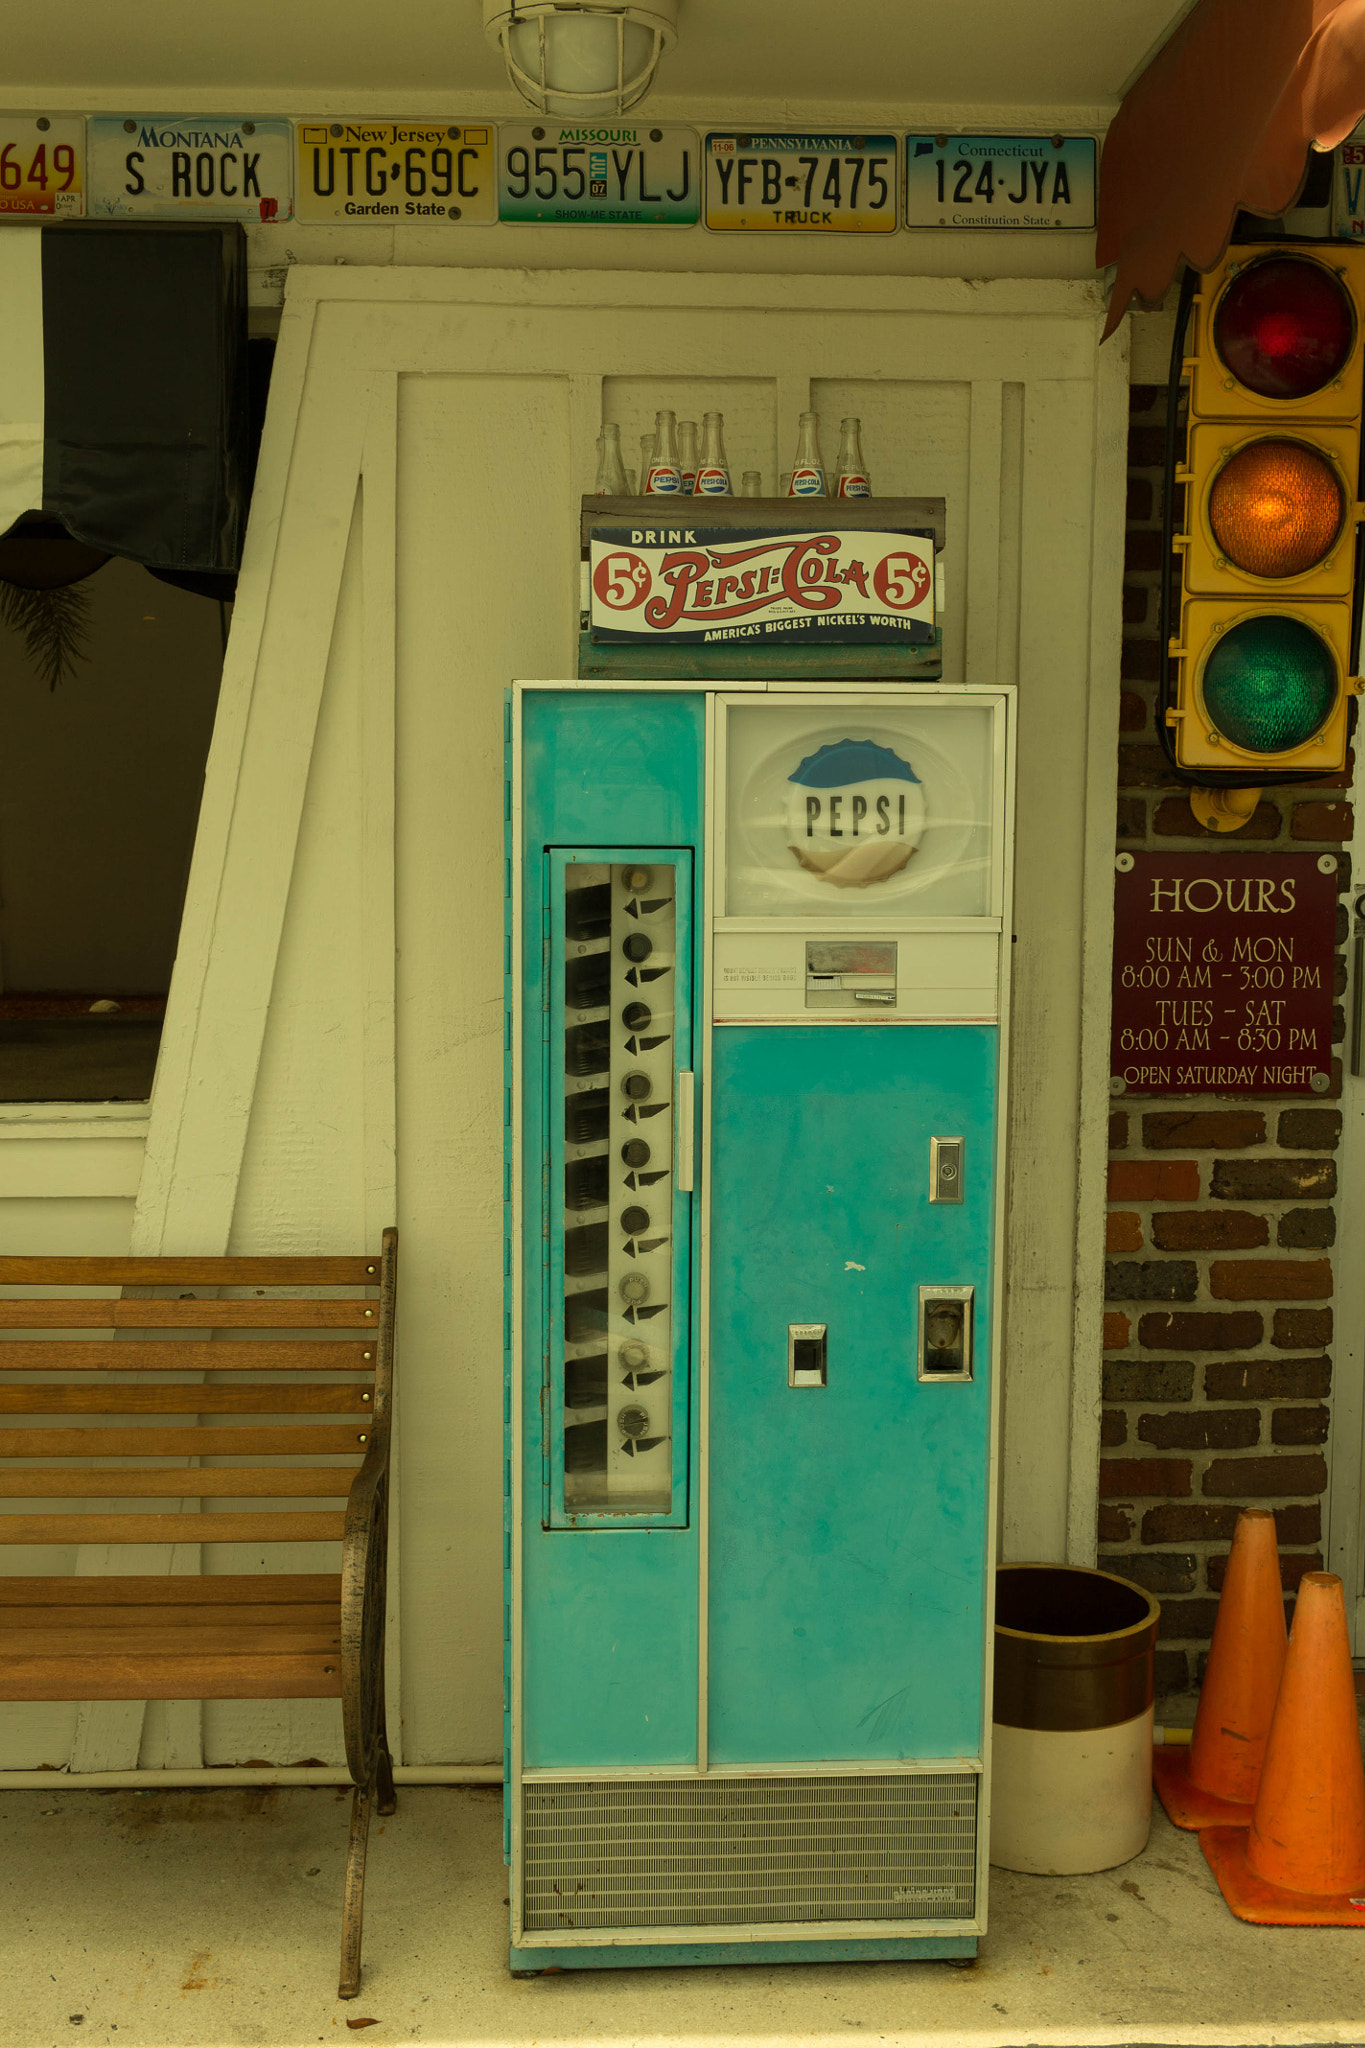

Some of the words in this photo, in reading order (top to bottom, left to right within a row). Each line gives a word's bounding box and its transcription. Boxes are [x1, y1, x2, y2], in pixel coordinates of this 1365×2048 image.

[137, 126, 244, 149] MONTANA
[345, 126, 388, 143] New
[390, 126, 447, 146] Jersey
[559, 129, 637, 143] MISSOURI
[751, 137, 853, 151] PENNSYLVANIA
[958, 143, 1043, 157] Connecticut
[0, 143, 75, 191] 649
[126, 152, 144, 195] S
[172, 152, 261, 198] ROCK
[507, 147, 586, 200] 955
[612, 150, 689, 202] YLJ
[591, 155, 606, 177] JUL
[11, 200, 35, 210] USA
[345, 202, 399, 215] Garden
[405, 202, 446, 215] State
[555, 210, 605, 219] SHOW-ME
[609, 211, 642, 220] STATE
[773, 211, 832, 224] TRUCK
[952, 214, 1020, 225] Constitution
[1023, 215, 1050, 226] State
[654, 476, 680, 484] PEPSI
[631, 530, 697, 544] DRINK
[606, 557, 647, 605] 5¢
[885, 557, 927, 605] 5¢
[704, 623, 761, 642] AMERICA'S
[765, 617, 811, 633] BIGGEST
[817, 614, 866, 627] NICKEL'S
[870, 615, 911, 631] WORTH
[806, 794, 905, 837] PEPSI
[1149, 878, 1296, 914] HOURS
[1145, 937, 1192, 963] SUN
[1202, 938, 1223, 962] &
[1232, 937, 1294, 963] MON
[1121, 965, 1170, 988] 8:00
[1177, 965, 1213, 988] AM
[1240, 966, 1285, 990] 3:00
[1292, 966, 1322, 989] PM
[1156, 1000, 1213, 1027] TUES
[1245, 1000, 1286, 1027] SAT
[1120, 1028, 1169, 1050] 8:00
[1175, 1028, 1210, 1050] AM
[1237, 1028, 1281, 1052] 8:30
[1289, 1028, 1317, 1050] PM
[1123, 1066, 1171, 1085] OPEN
[1177, 1065, 1258, 1085] SATURDAY
[1262, 1066, 1317, 1085] NIGHT
